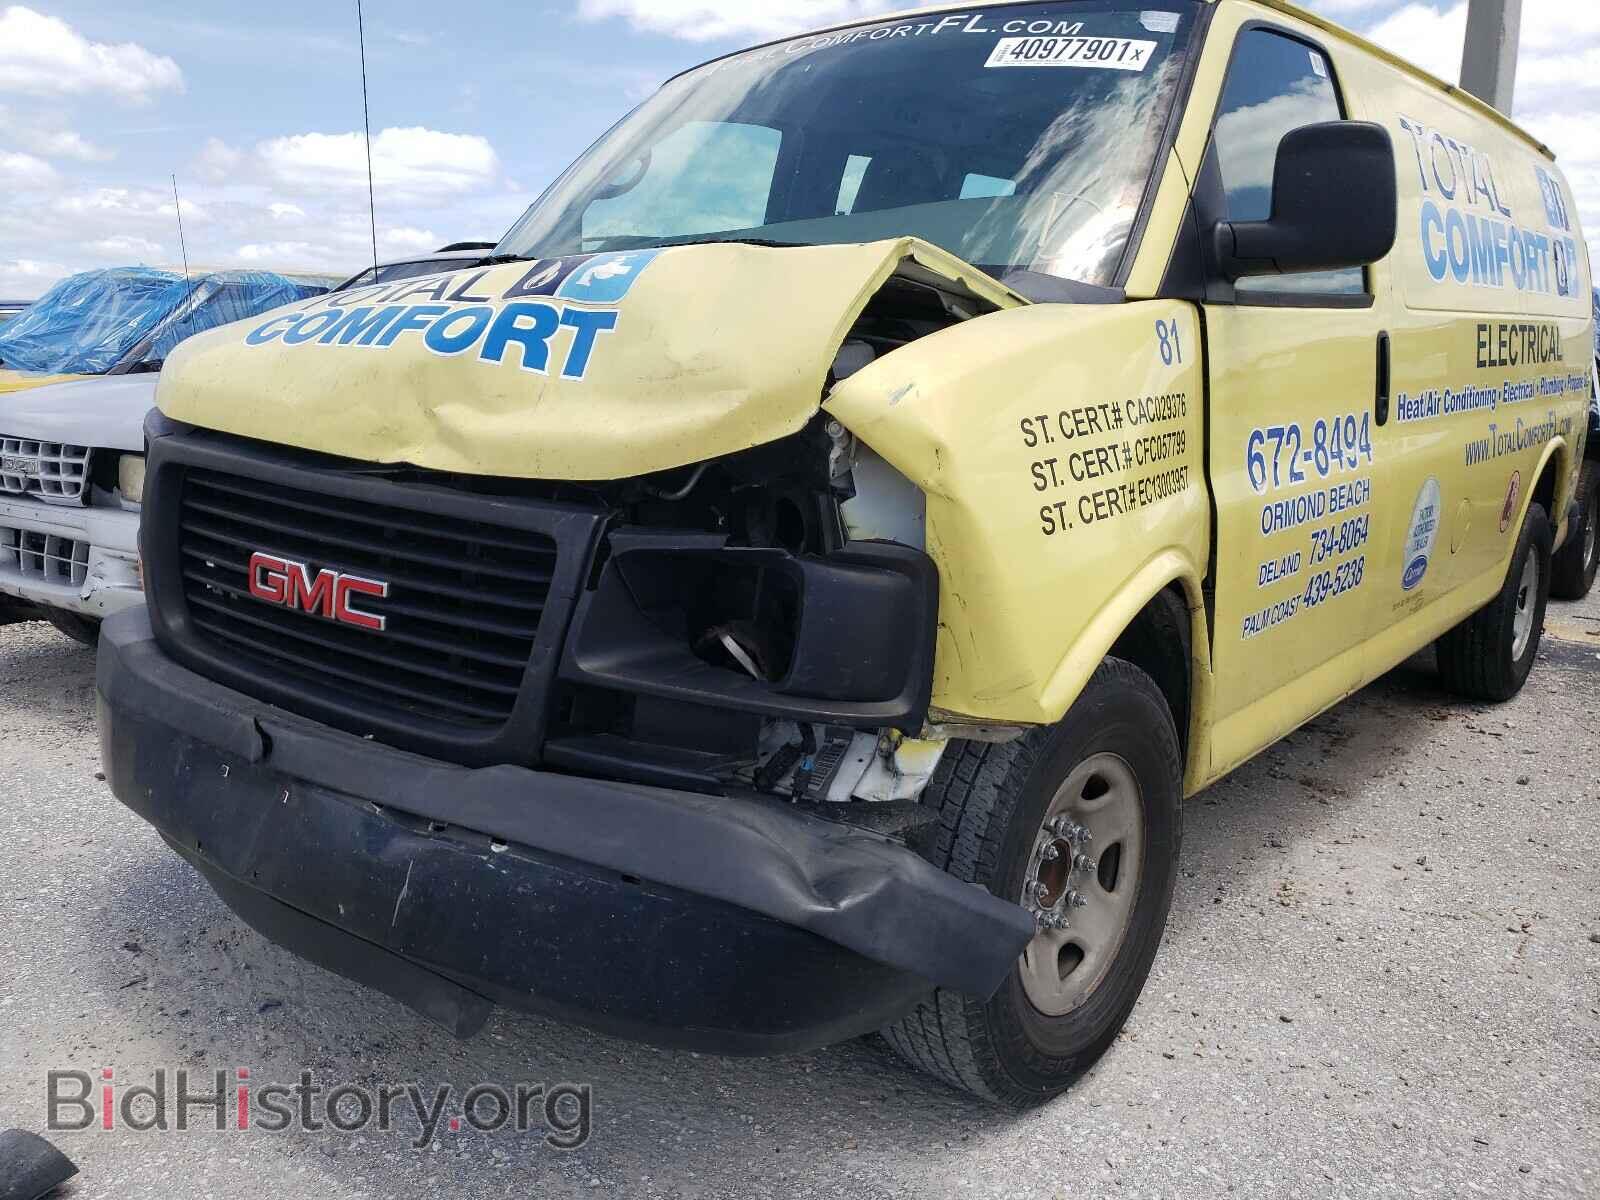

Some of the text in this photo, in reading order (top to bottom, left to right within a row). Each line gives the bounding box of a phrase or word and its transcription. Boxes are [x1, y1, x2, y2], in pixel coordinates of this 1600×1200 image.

[1398, 117, 1512, 218] TOTAL
[1420, 199, 1551, 293] COMFORT
[244, 302, 618, 381] COMFORT
[1155, 318, 1183, 366] 81
[1476, 323, 1563, 368] ELECTRICAL
[1020, 415, 1054, 447] ST.
[1125, 393, 1186, 426] CAC029376
[1397, 391, 1441, 422] Heat/Air
[1443, 384, 1497, 412] Conditioning
[1503, 380, 1535, 403] Electrical
[1540, 375, 1564, 397] Plumbing
[1031, 458, 1065, 491] ST.
[1135, 430, 1185, 466] CFC057799
[1247, 410, 1372, 495] 672-8494
[1039, 501, 1073, 535] ST.
[1138, 466, 1188, 506] EC13003957
[1261, 478, 1370, 535] ORMOND BEACH
[1258, 552, 1301, 587] DELAND
[1309, 514, 1370, 565] 734-8064
[249, 551, 387, 631] GMC
[1241, 607, 1270, 639] PALM
[1270, 594, 1302, 625] COAST
[1302, 556, 1365, 609] 439-5238
